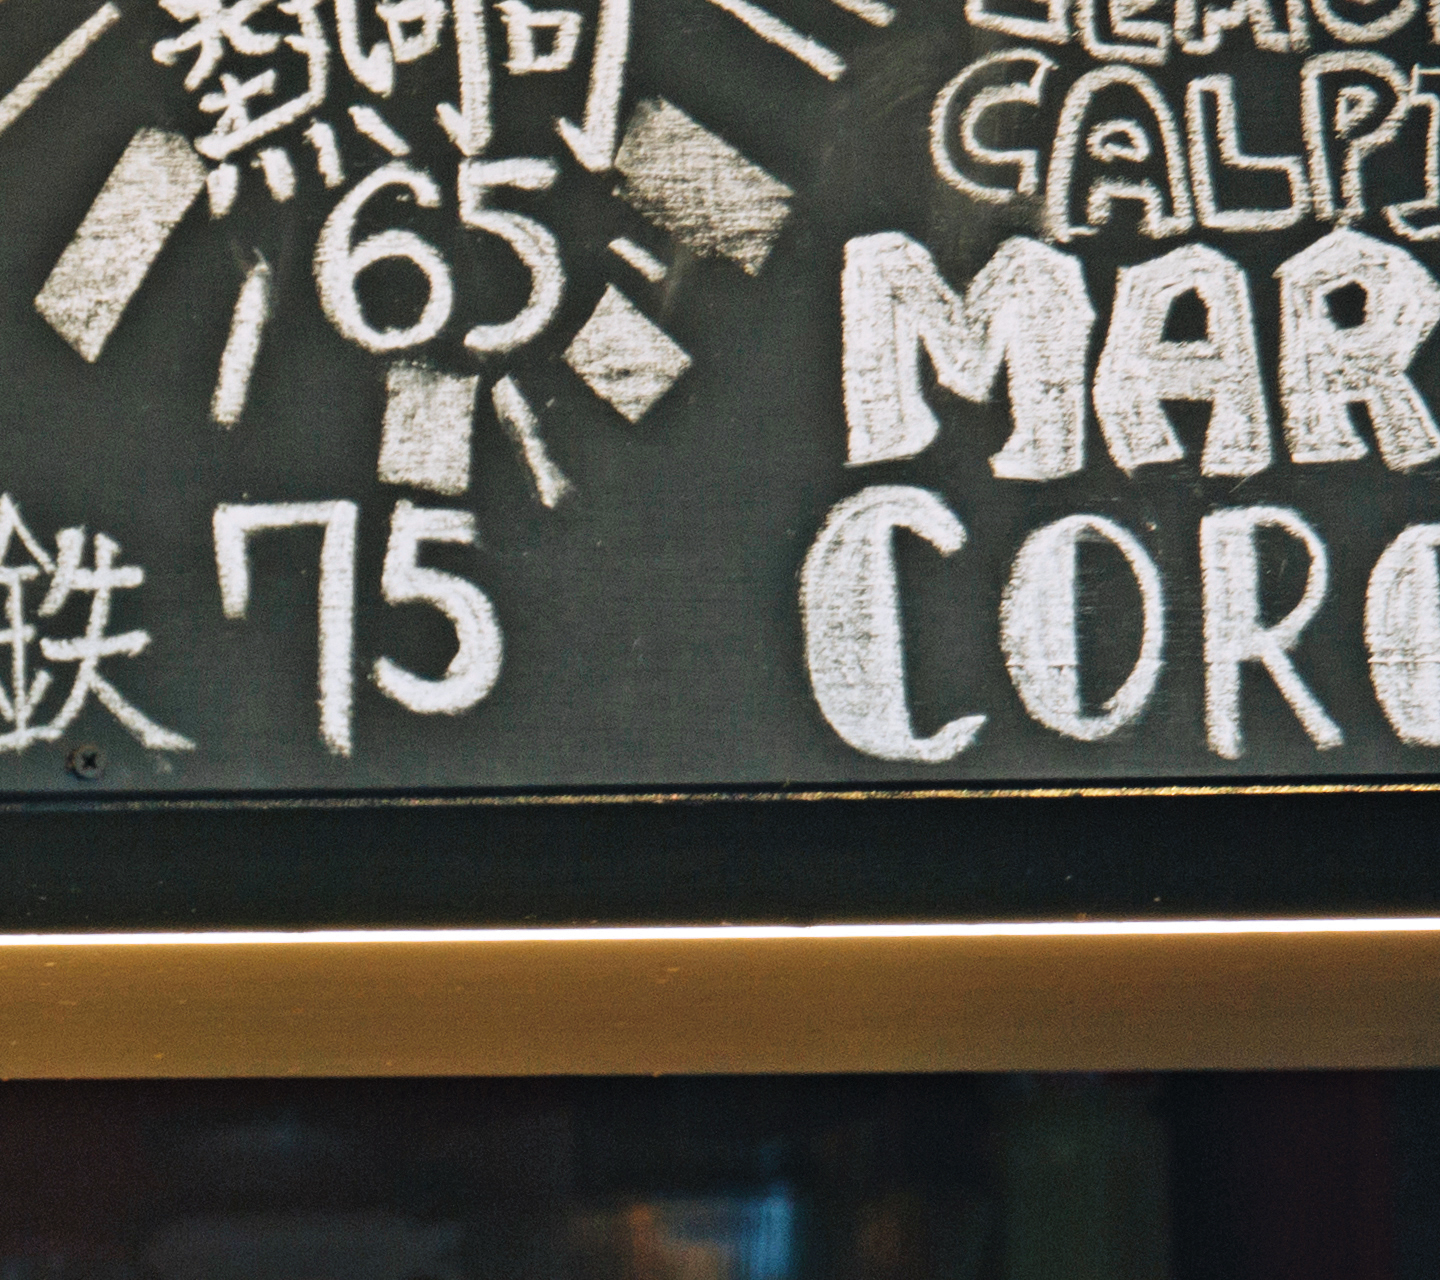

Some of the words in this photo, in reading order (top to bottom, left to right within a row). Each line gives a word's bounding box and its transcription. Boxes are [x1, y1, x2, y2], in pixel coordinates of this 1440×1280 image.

[313, 160, 567, 353] 65
[841, 229, 1440, 482] MAR
[212, 499, 503, 757] 75
